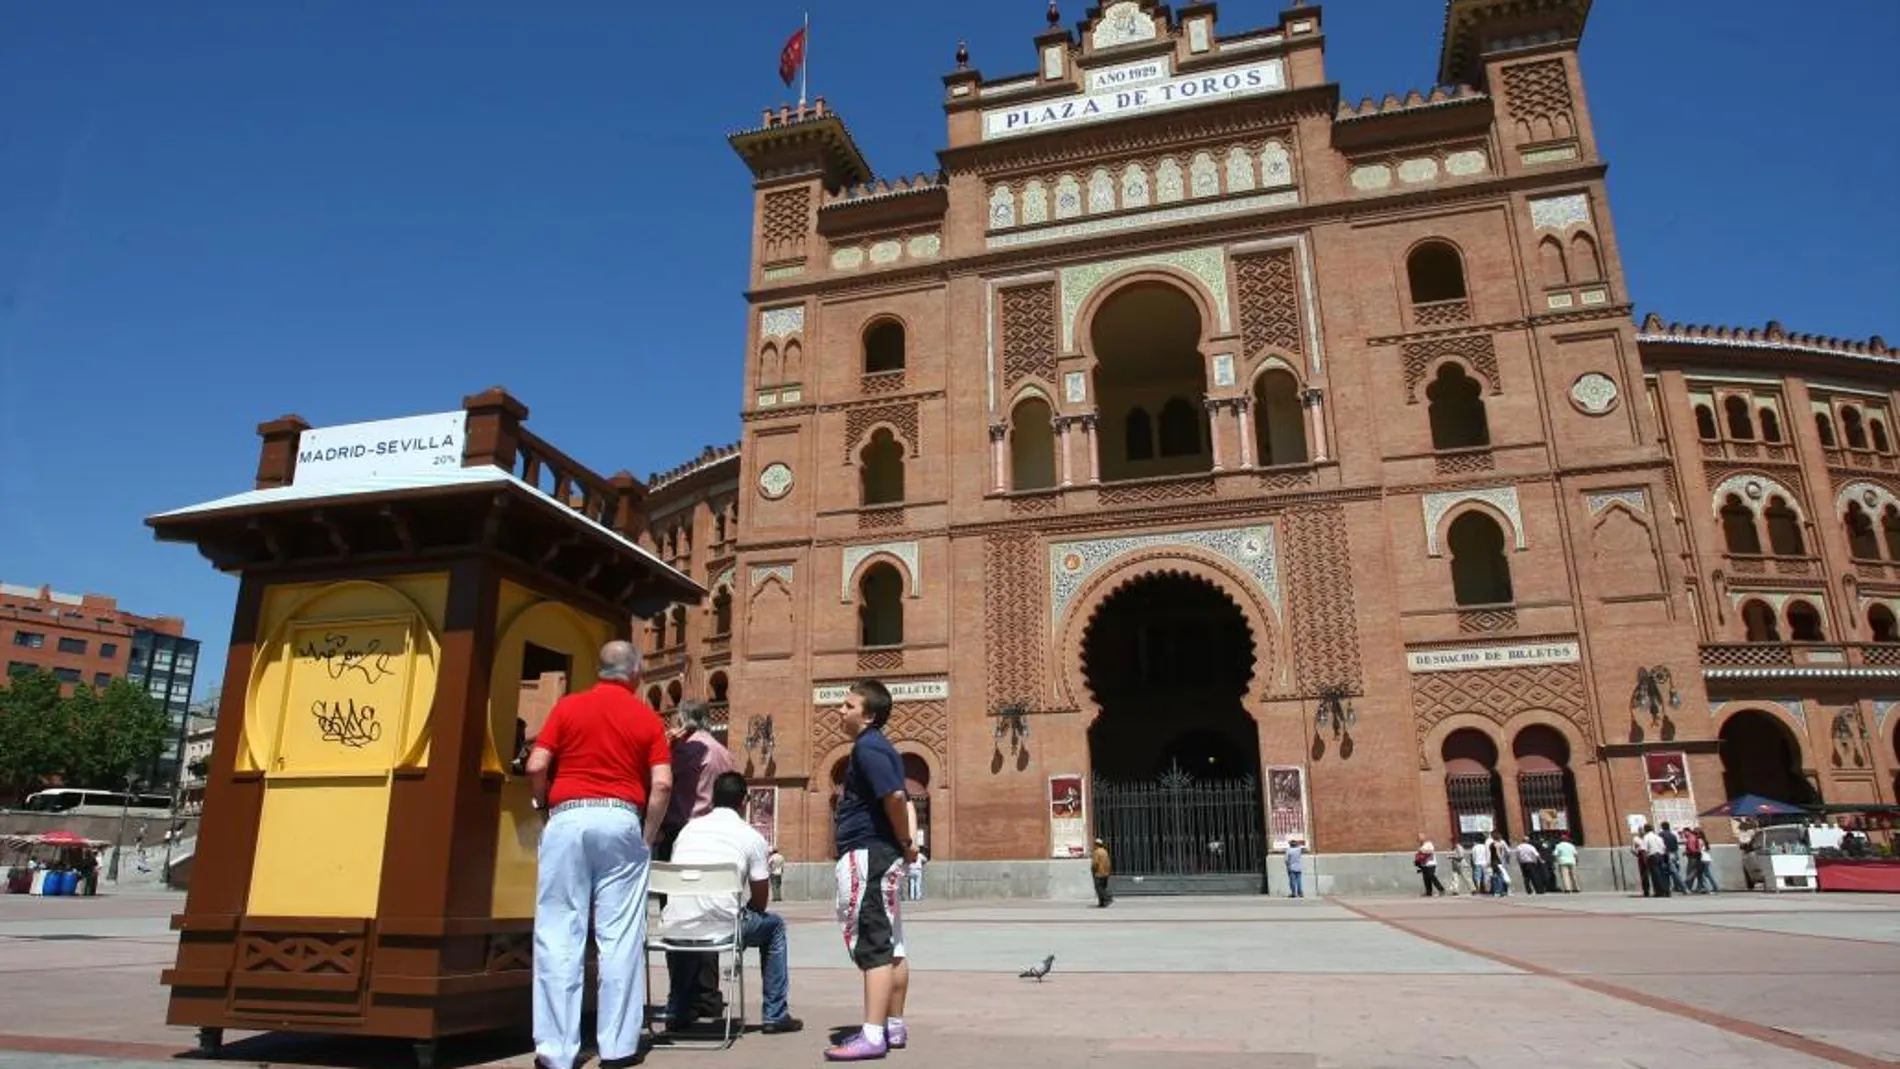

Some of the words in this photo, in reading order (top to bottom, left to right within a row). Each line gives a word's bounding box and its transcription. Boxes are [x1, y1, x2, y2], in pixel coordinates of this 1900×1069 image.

[1128, 63, 1157, 81] 1929
[1006, 98, 1100, 128] PLAZA
[1116, 90, 1148, 108] DE
[1160, 69, 1262, 100] TOROS
[299, 434, 455, 464] MADRID-SEVILLA
[1415, 653, 1480, 665] DESPACHO
[1484, 651, 1501, 661] DE
[1508, 647, 1572, 660] BILLETES
